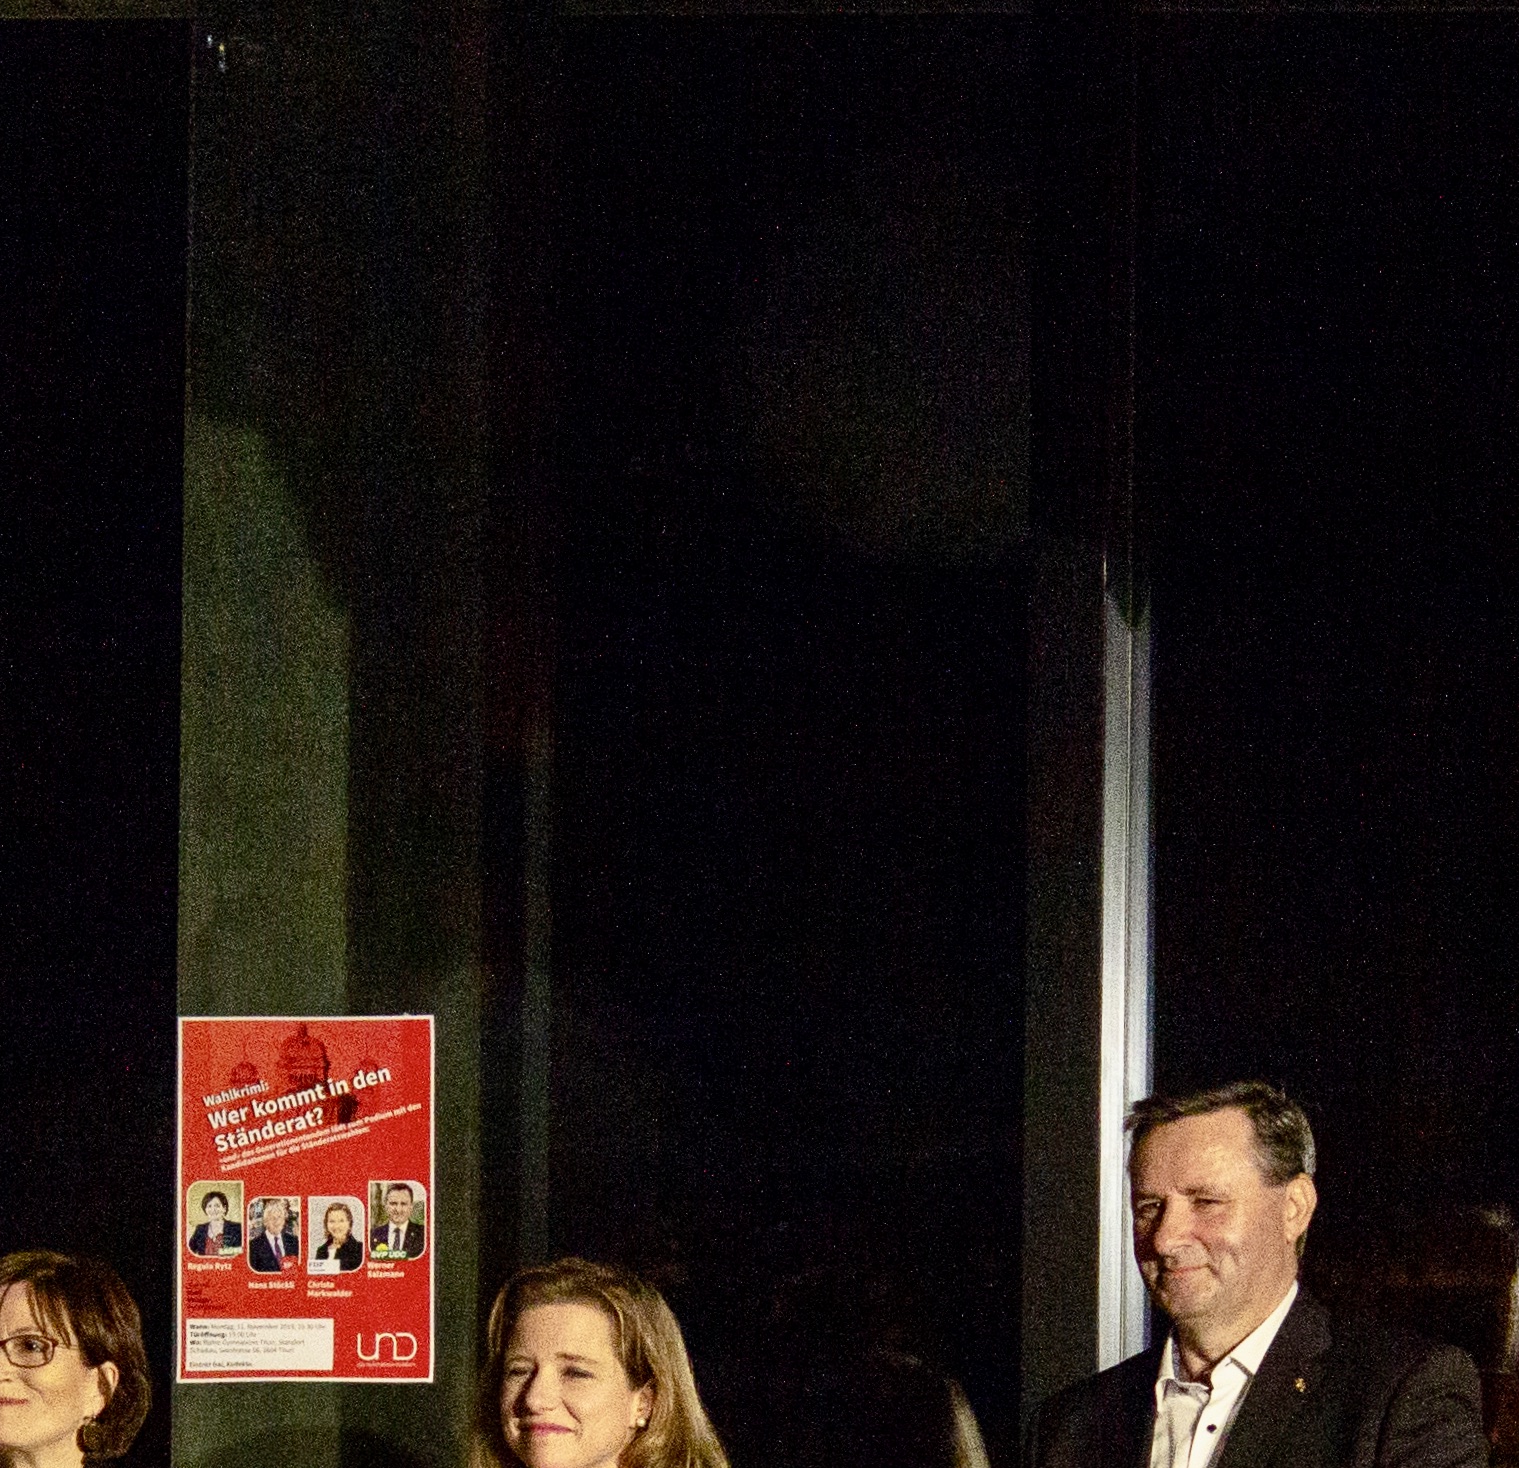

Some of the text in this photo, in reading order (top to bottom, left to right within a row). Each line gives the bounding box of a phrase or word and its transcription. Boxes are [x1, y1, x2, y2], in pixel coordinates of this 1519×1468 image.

[202, 1079, 270, 1108] Wahlkrimi:
[207, 1066, 392, 1130] Wer kommt in den
[213, 1107, 324, 1153] Ständerat?
[368, 1261, 395, 1270] Werner
[368, 1270, 405, 1279] Salzmann
[307, 1280, 334, 1289] Christa
[307, 1289, 353, 1298] Markwalder
